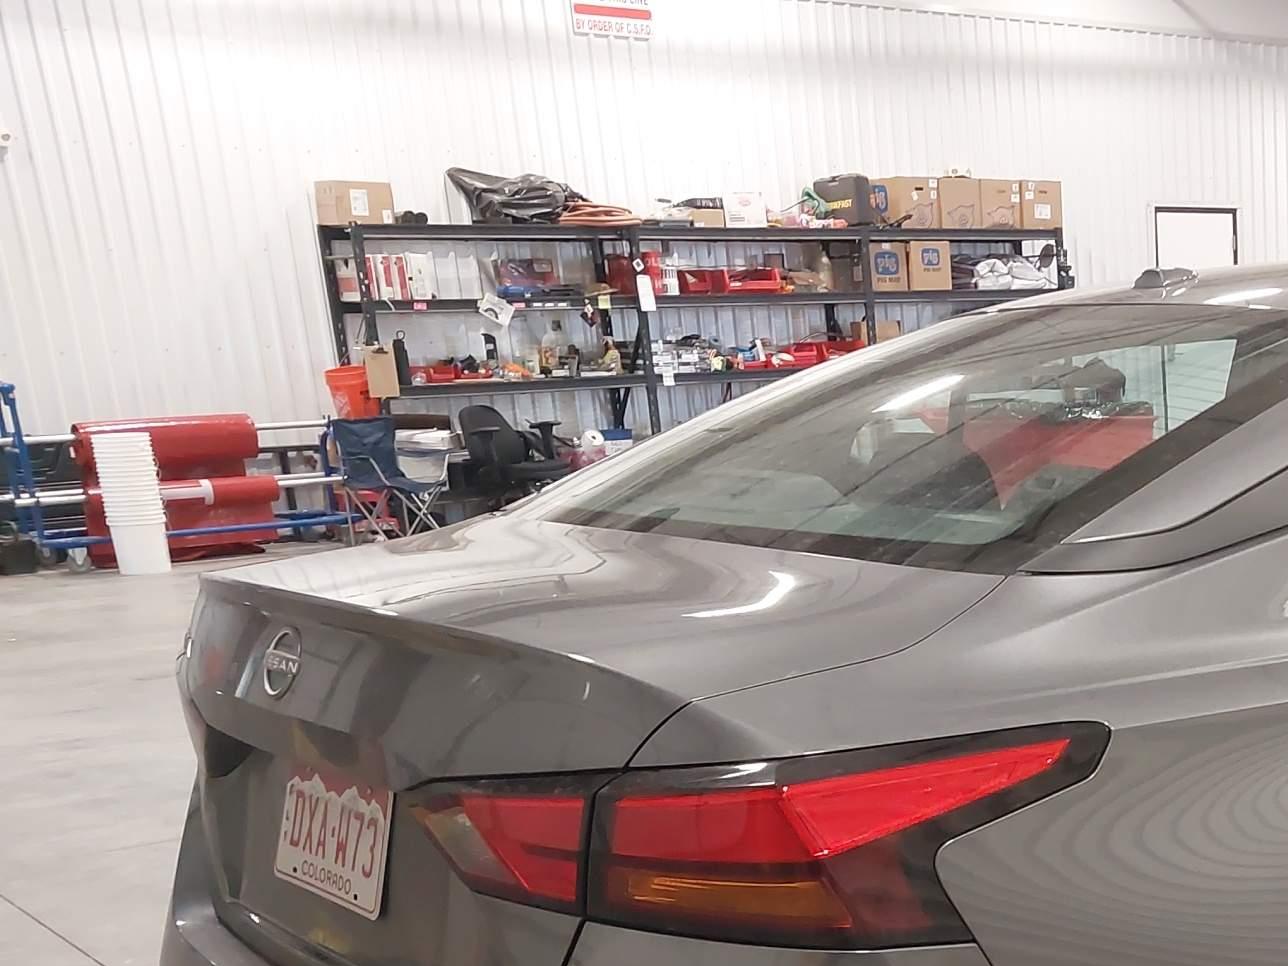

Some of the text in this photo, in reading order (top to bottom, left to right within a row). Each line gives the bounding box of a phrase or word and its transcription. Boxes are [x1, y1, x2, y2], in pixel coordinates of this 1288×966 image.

[575, 18, 585, 30] BY
[587, 19, 613, 33] ORDER
[614, 22, 625, 33] OF
[300, 860, 352, 895] COLORADO
